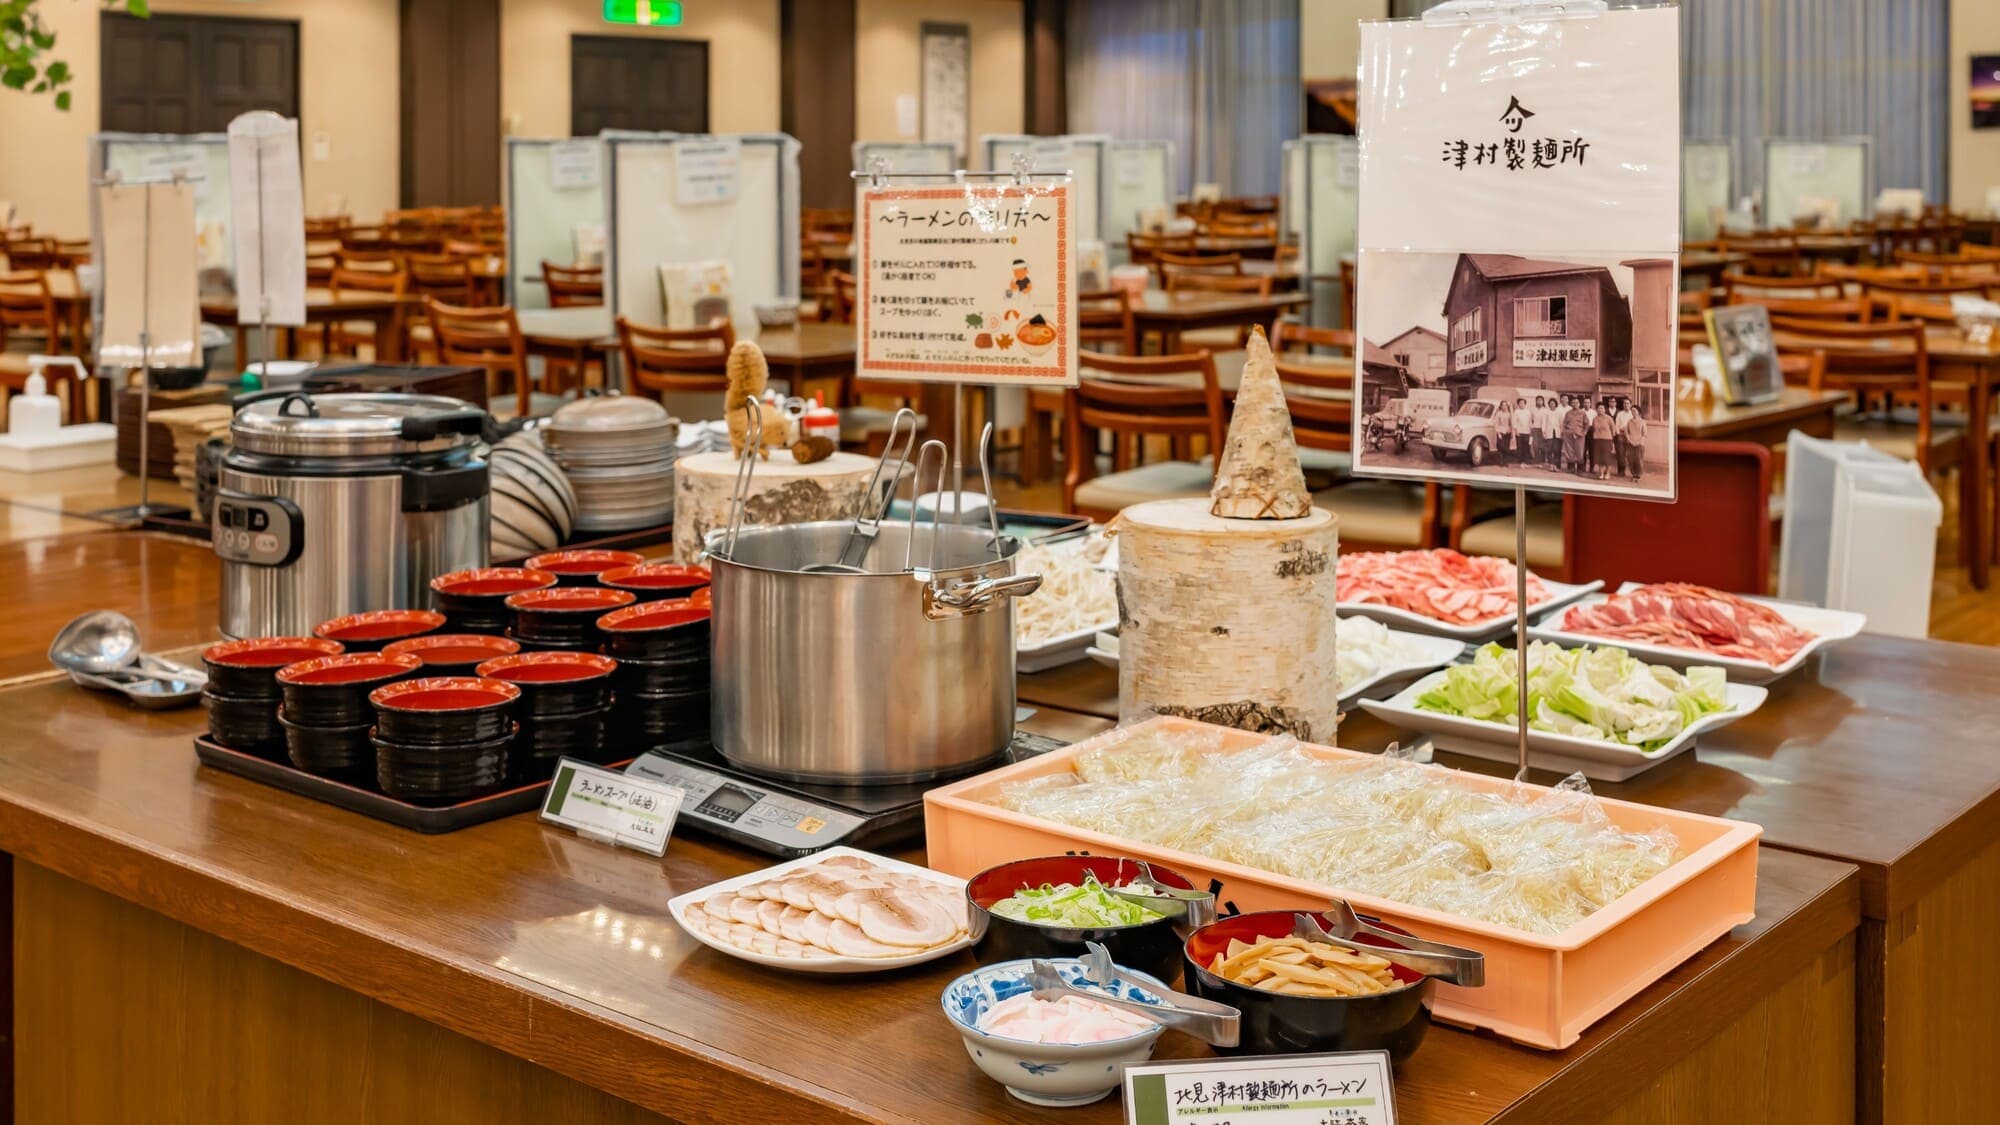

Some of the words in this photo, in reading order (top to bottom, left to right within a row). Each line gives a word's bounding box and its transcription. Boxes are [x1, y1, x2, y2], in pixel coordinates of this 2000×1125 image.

[1442, 137, 1591, 171] 津村製麺所
